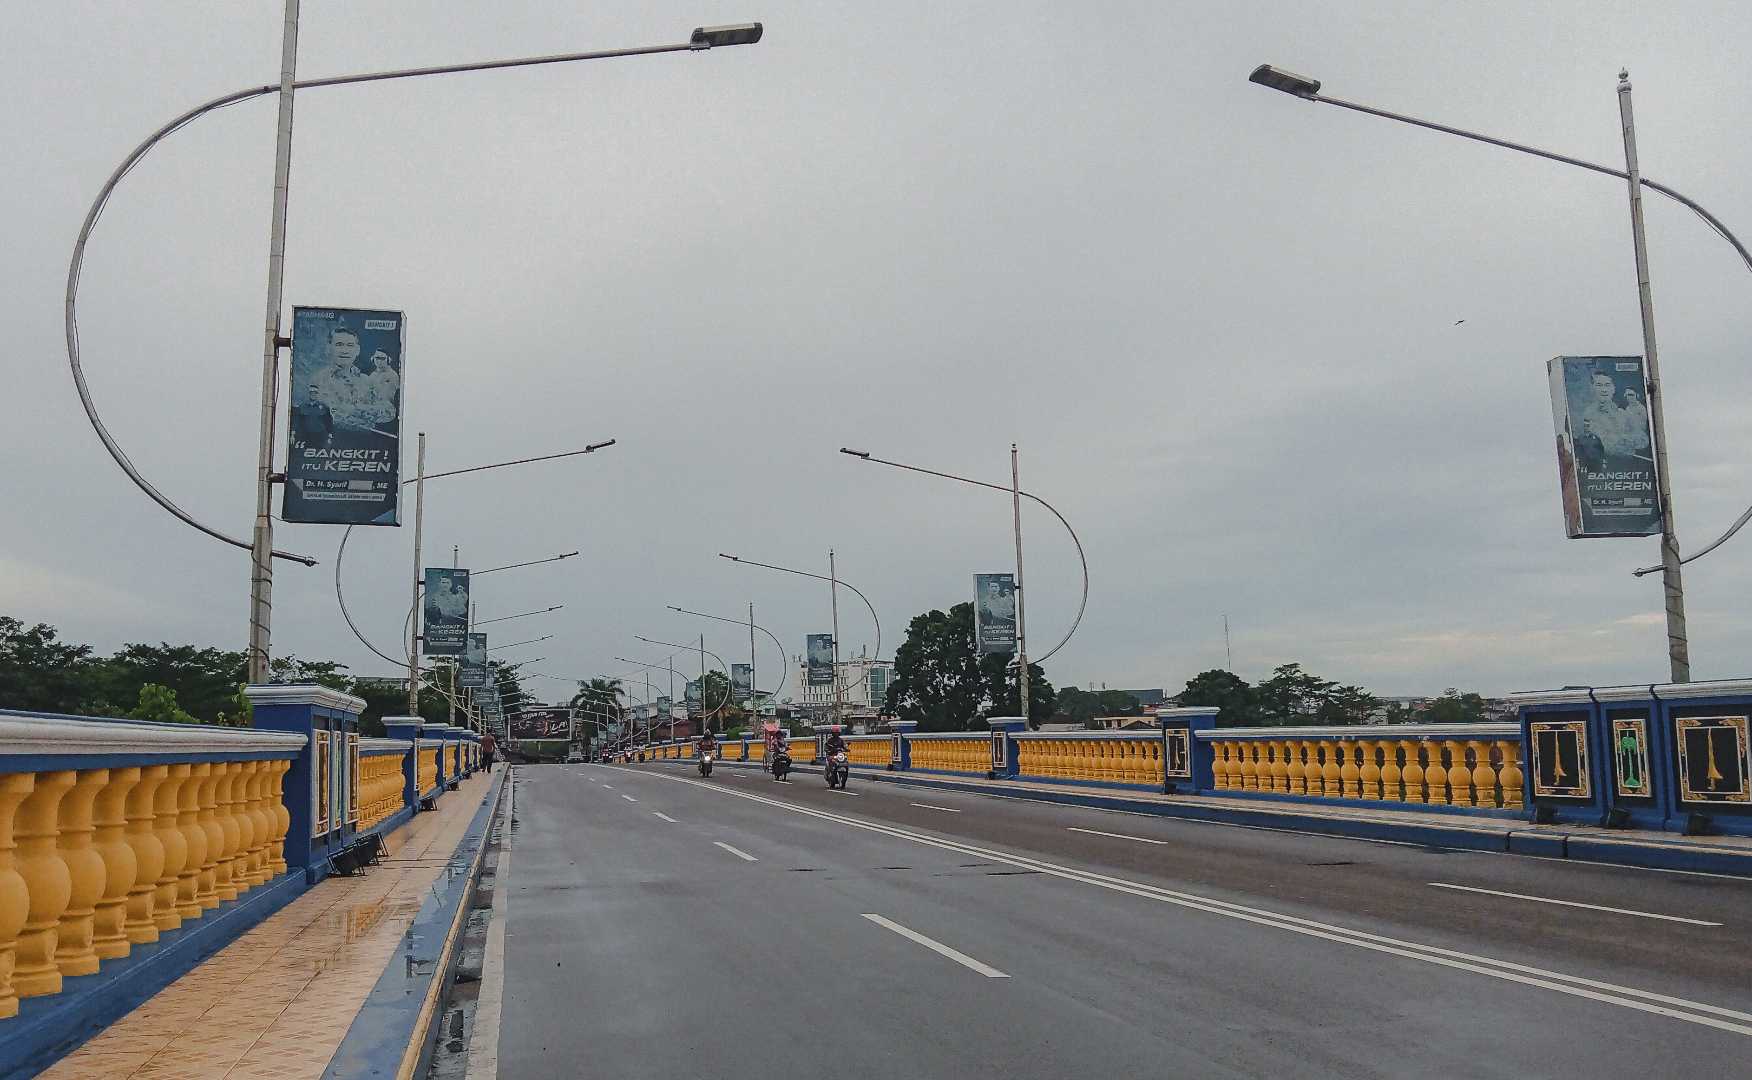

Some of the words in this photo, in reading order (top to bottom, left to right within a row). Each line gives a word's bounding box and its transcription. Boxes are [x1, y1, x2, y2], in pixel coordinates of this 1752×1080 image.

[303, 448, 380, 459] BANGKIT
[324, 460, 391, 473] KEREN
[1587, 471, 1642, 480] BANGKIT
[1604, 481, 1652, 491] KEREN
